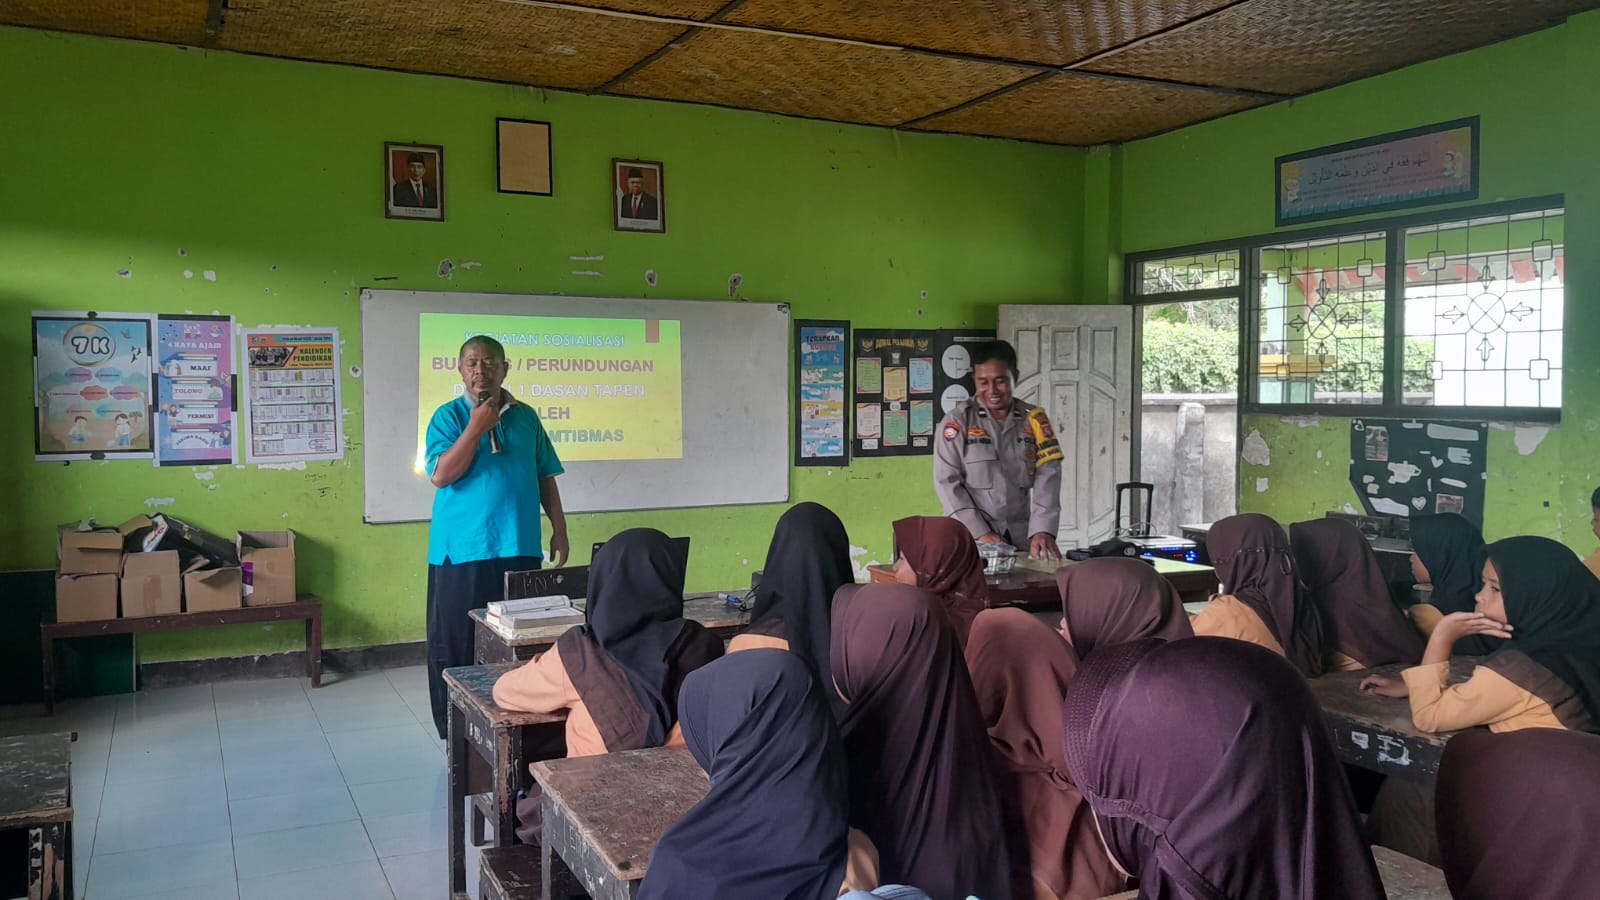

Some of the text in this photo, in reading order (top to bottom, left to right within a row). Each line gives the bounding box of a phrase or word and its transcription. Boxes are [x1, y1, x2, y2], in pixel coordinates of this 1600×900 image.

[543, 334, 625, 347] SOSIALISASI
[526, 358, 654, 373] PERUNDUNGAN
[530, 384, 589, 398] DASAN
[593, 384, 646, 397] TAPEN
[537, 406, 570, 420] LEH
